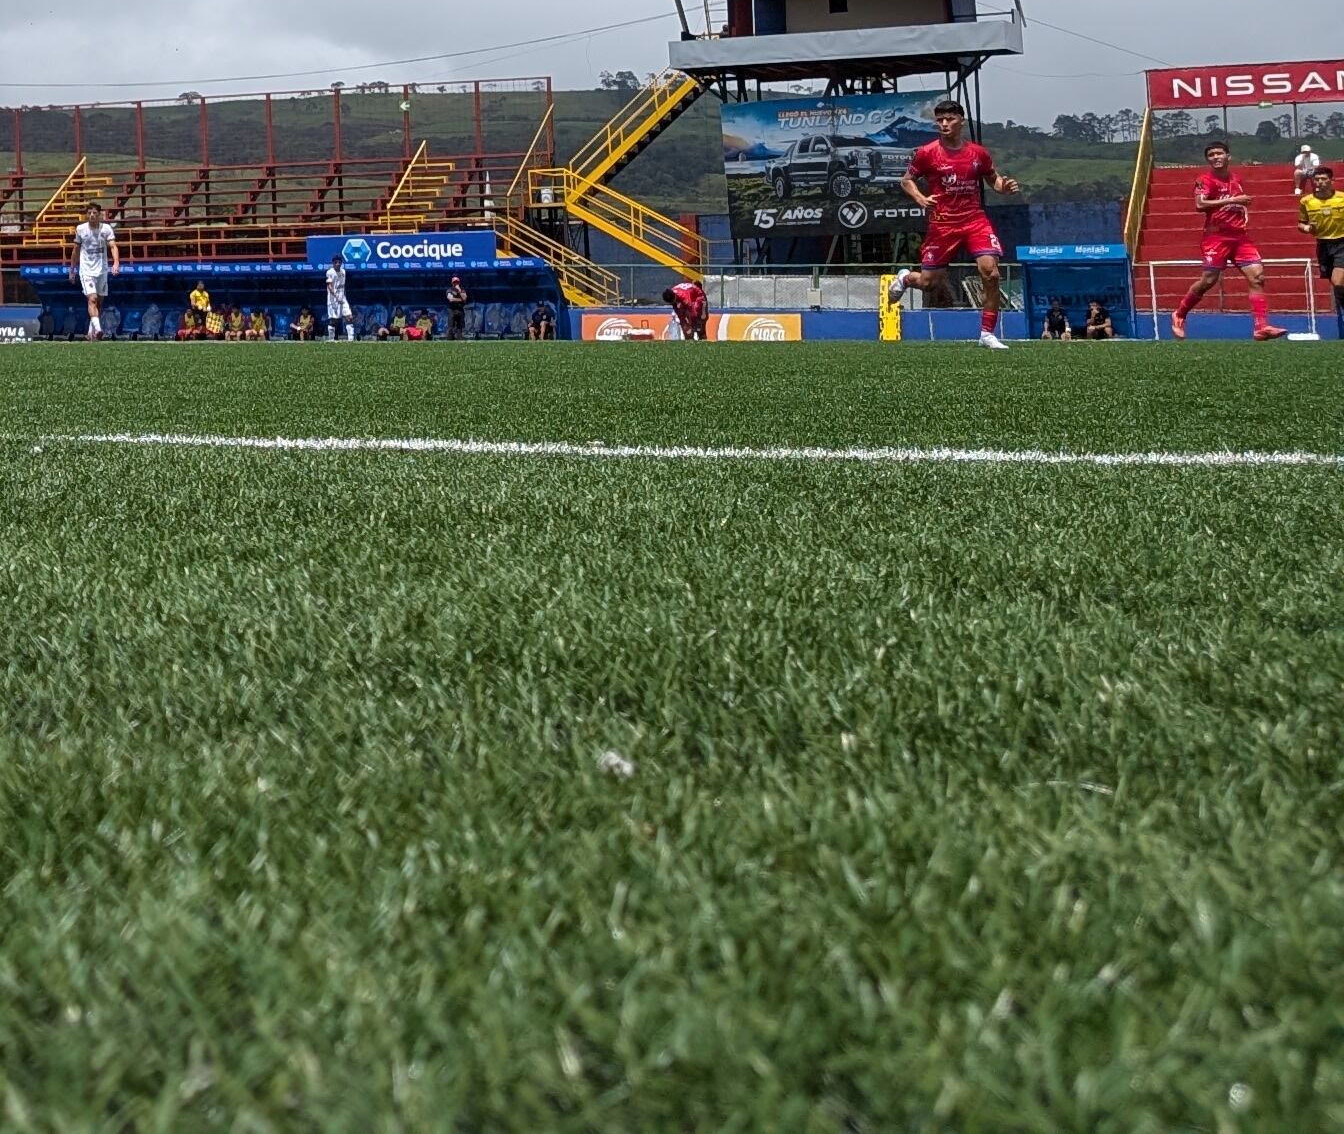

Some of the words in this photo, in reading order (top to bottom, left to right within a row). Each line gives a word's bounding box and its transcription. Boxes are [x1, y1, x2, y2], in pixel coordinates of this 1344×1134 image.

[1172, 70, 1344, 99] NISSA
[777, 112, 866, 129] TUNLAND
[753, 208, 779, 229] 15
[782, 206, 823, 220] AÑOS
[873, 207, 926, 218] FOTO
[376, 239, 463, 259] Coocique
